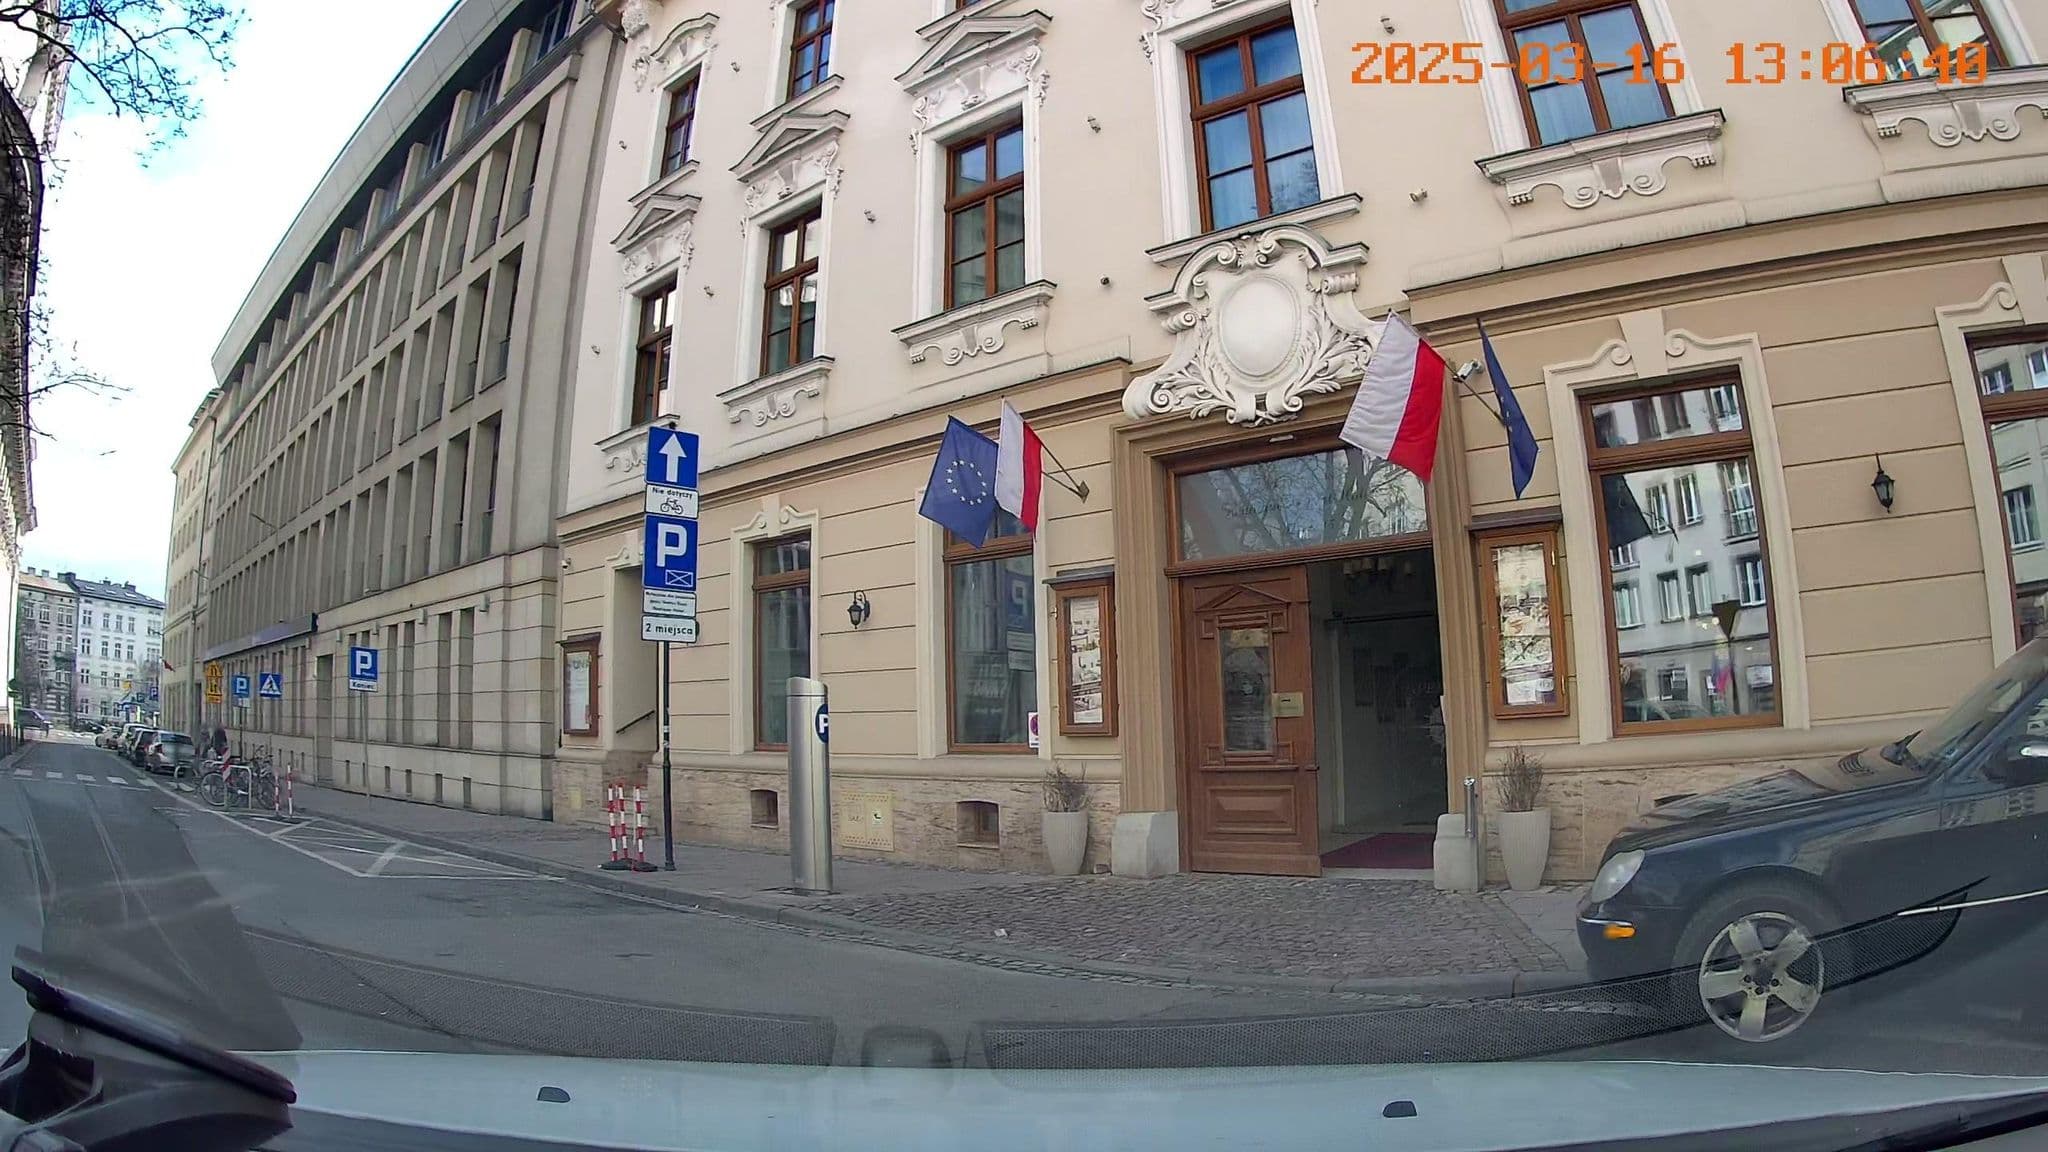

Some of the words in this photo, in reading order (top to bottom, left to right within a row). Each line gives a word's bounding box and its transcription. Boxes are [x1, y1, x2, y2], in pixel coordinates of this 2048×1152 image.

[667, 489, 692, 499] dotyczy
[656, 523, 687, 567] P
[645, 623, 651, 632] 2
[655, 624, 693, 636] miejsca
[355, 650, 372, 675] P
[236, 677, 247, 693] P
[818, 713, 829, 734] P
